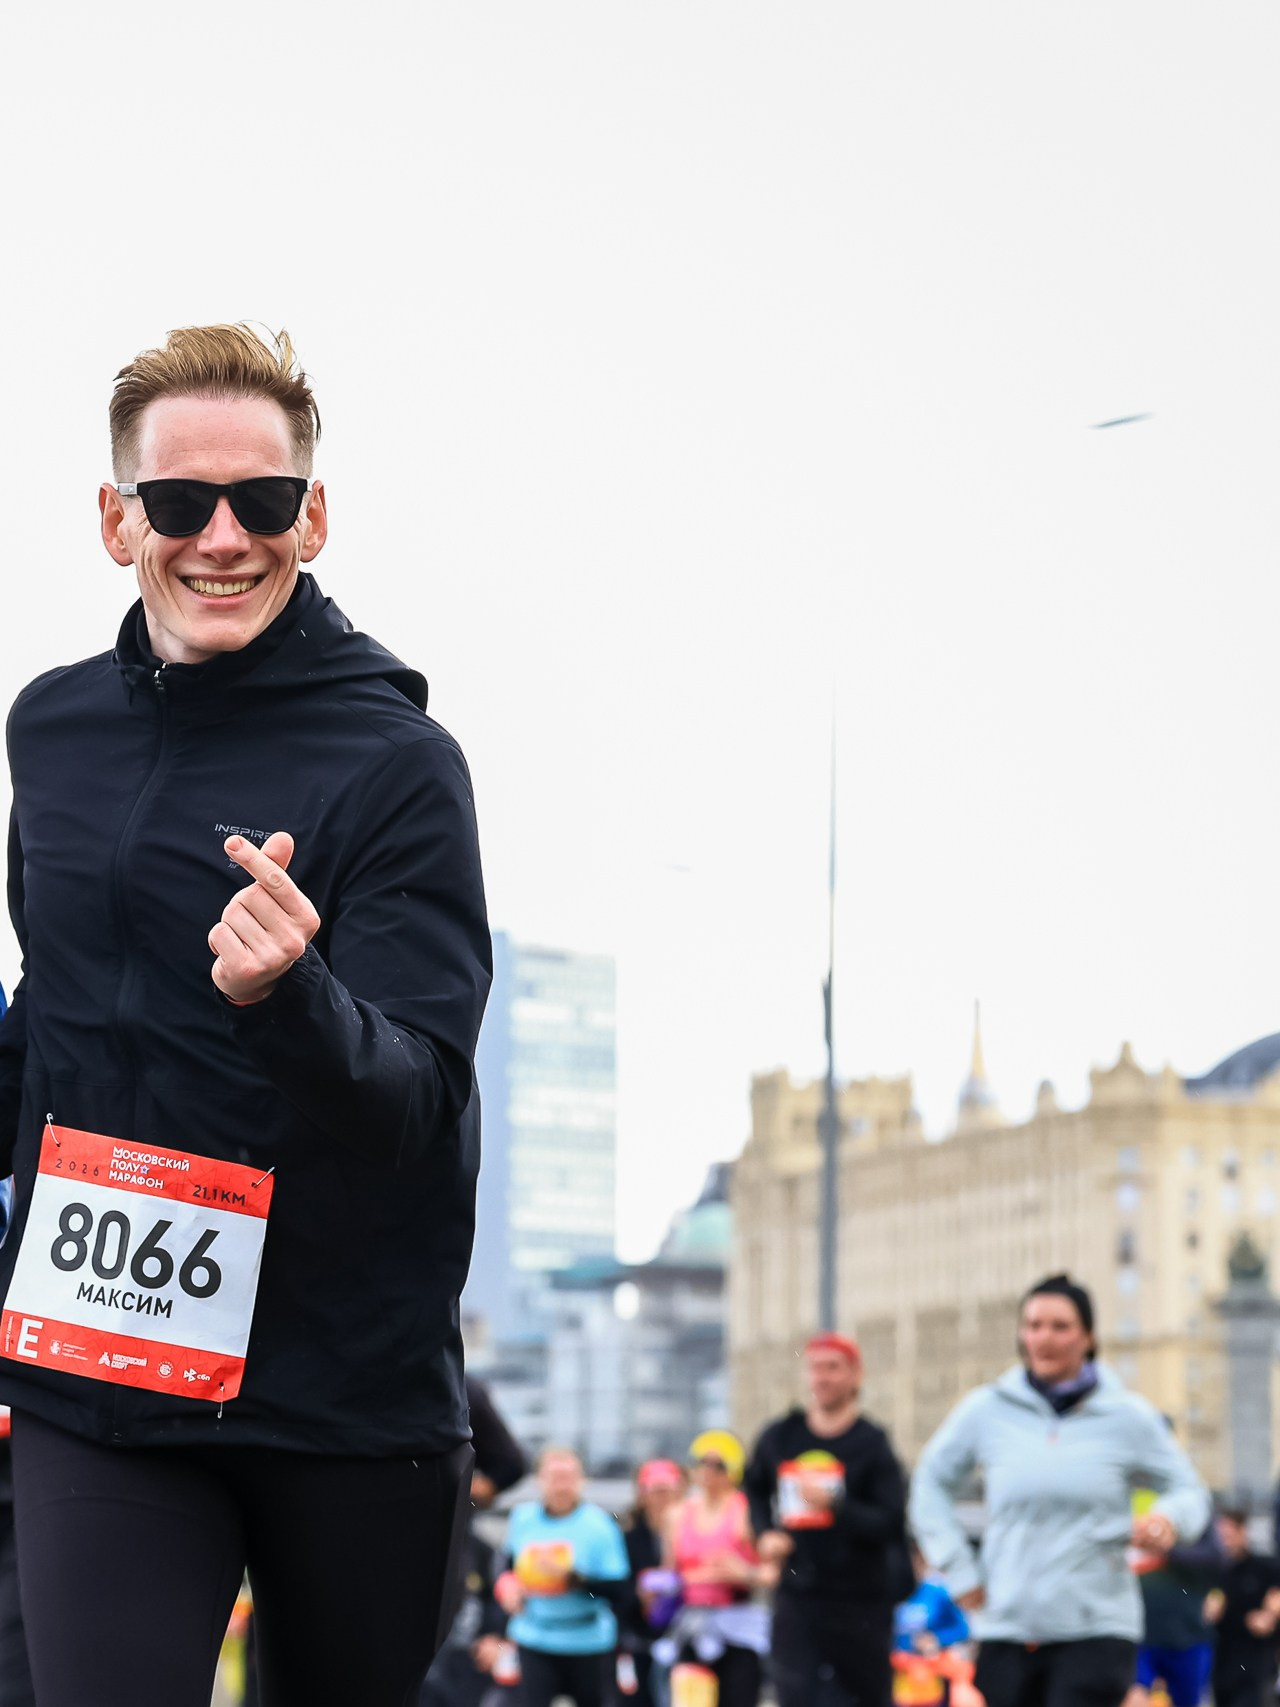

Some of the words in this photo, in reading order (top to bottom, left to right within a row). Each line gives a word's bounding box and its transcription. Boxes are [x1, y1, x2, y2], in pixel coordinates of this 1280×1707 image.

[55, 1158, 100, 1177] 2026
[110, 1159, 140, 1173] ПОЛУ
[112, 1146, 190, 1172] МОСКОВСКИЙ
[108, 1170, 164, 1189] МАРАФОН
[50, 1202, 222, 1299] 8066
[76, 1282, 174, 1319] МАКСИМ
[16, 1317, 44, 1359] E
